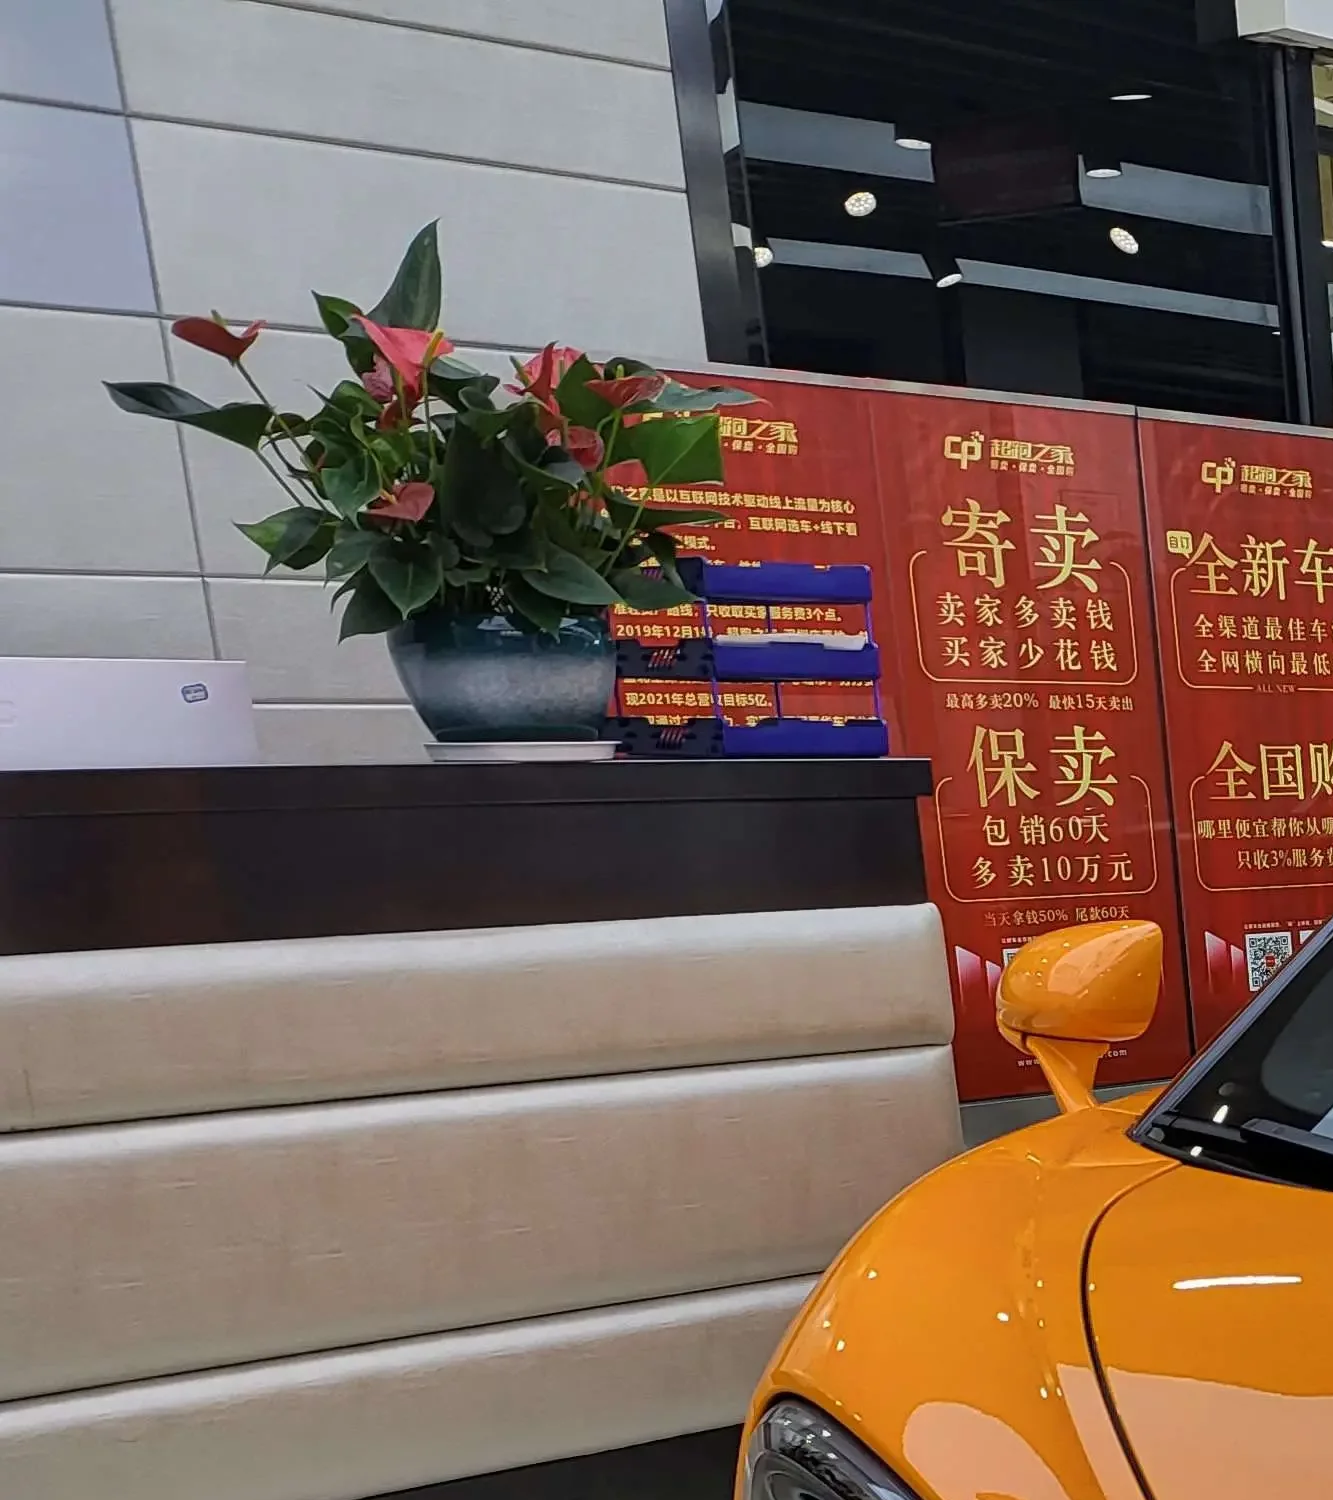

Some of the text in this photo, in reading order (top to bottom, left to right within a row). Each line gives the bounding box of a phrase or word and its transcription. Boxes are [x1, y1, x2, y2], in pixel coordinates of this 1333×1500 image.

[989, 439, 1075, 465] 超跑之家
[1240, 464, 1313, 489] 超跑之家
[941, 497, 1103, 593] 寄卖
[936, 591, 1114, 632] 卖家多卖钱
[940, 636, 1118, 672] 买家少花钱
[945, 692, 1134, 712] 最高多卖20% 最快15天卖出
[1256, 684, 1273, 694] ALL
[966, 725, 1119, 808] 保卖
[982, 812, 1110, 847] 包销60天
[971, 852, 1134, 890] 多卖10万元
